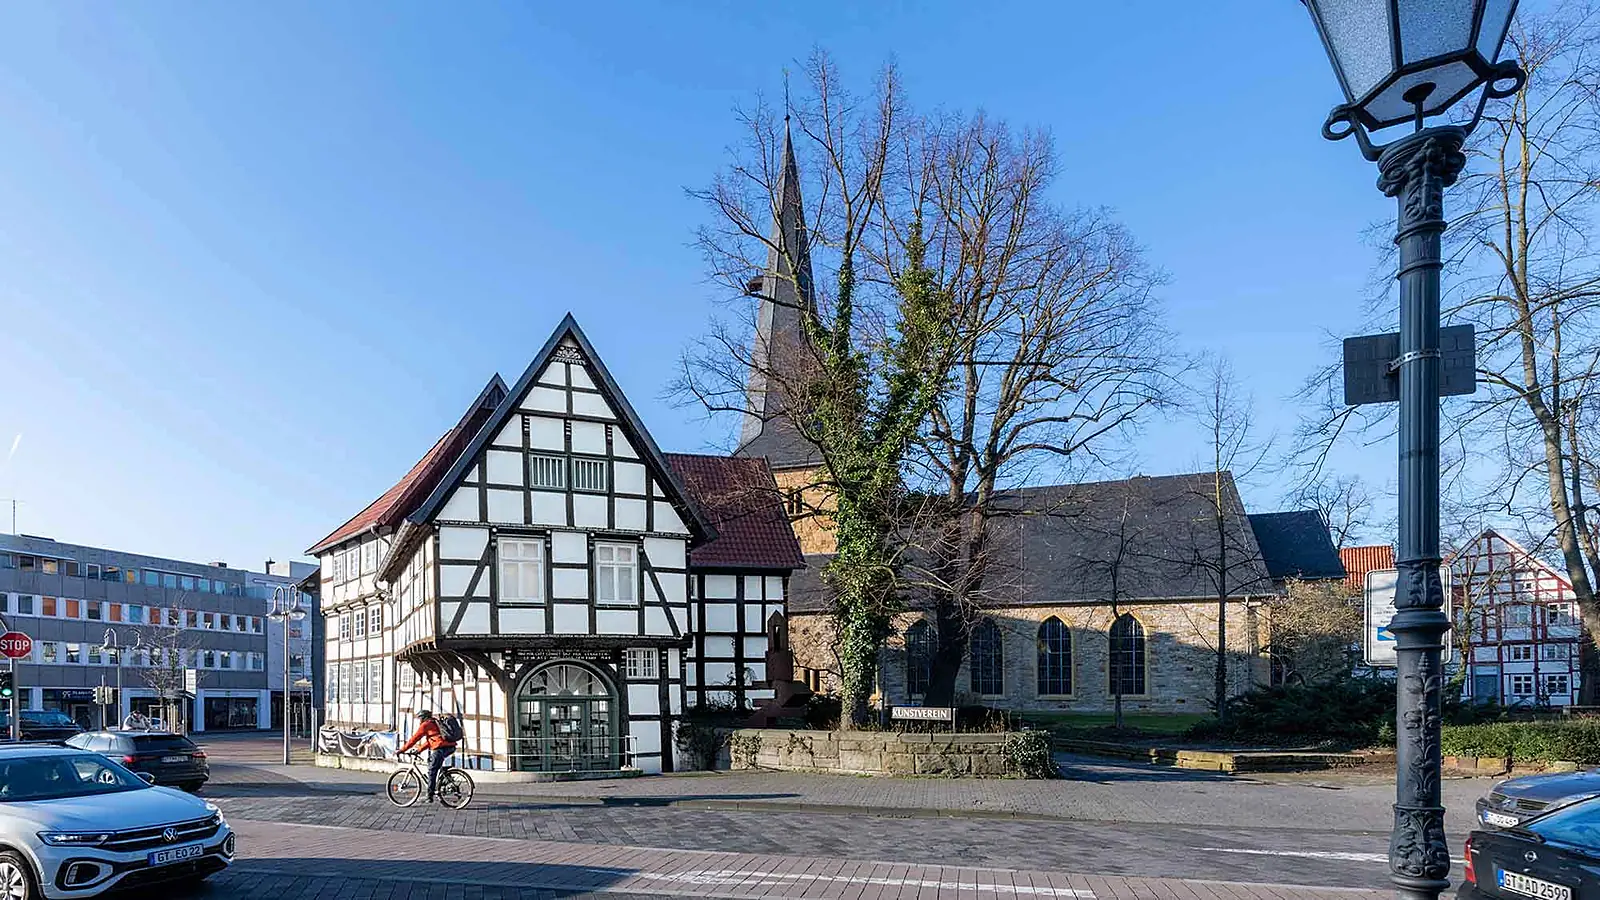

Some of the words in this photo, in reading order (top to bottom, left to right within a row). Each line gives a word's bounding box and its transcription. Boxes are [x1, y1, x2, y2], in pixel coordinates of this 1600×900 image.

[0, 640, 30, 650] STOP
[892, 708, 947, 718] KUNSTVEREIN
[157, 852, 169, 862] GT
[190, 846, 200, 856] 22
[1505, 873, 1517, 888] GT
[1525, 879, 1538, 894] AD
[1540, 883, 1569, 900] 2599
